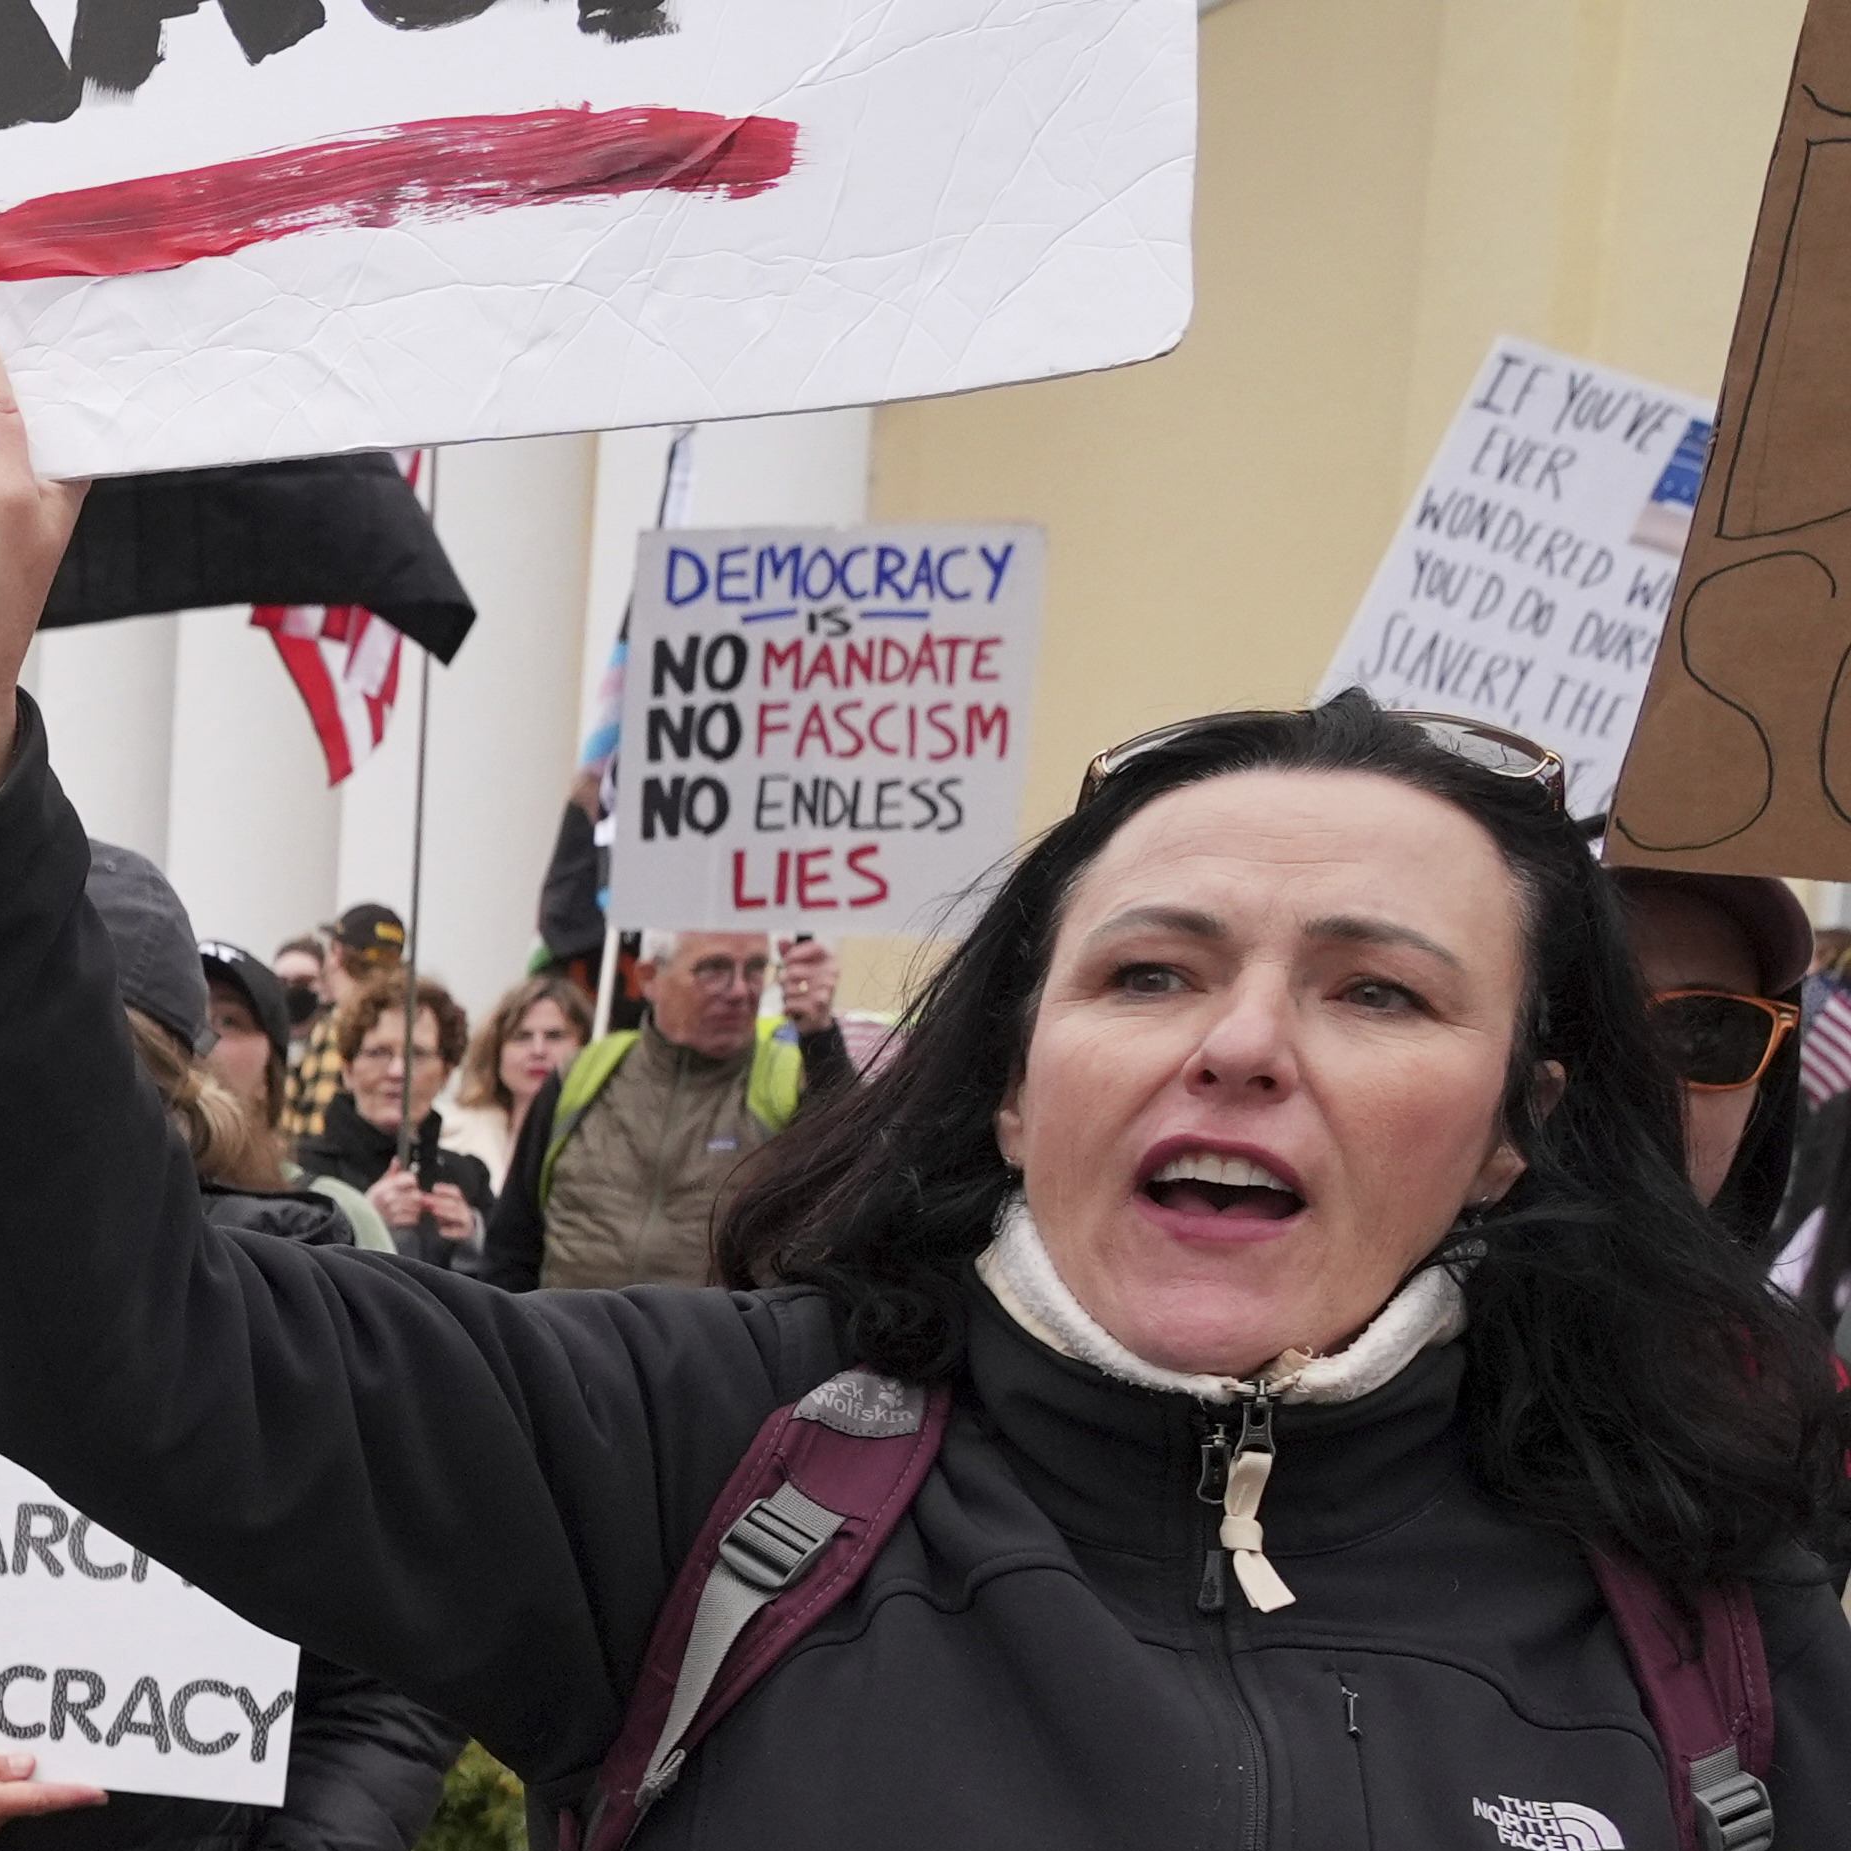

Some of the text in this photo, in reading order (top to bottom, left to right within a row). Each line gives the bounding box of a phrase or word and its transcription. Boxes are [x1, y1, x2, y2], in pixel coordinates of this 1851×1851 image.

[1473, 352, 1687, 452] IF YOU'VE
[1470, 424, 1577, 500] EVER
[1415, 487, 1615, 590] WONDERED
[665, 543, 1014, 606] DEMOCRACY
[1409, 549, 1504, 622] YOU'D
[1507, 586, 1556, 637] DO
[651, 630, 1003, 697] NO MANDATE
[646, 701, 1010, 763] NO FASCISM
[1543, 672, 1631, 737] THE
[640, 773, 965, 840] NO ENDLESS
[731, 845, 889, 911] LIES
[1472, 1797, 1563, 1836] NORTH
[1498, 1794, 1552, 1819] THE
